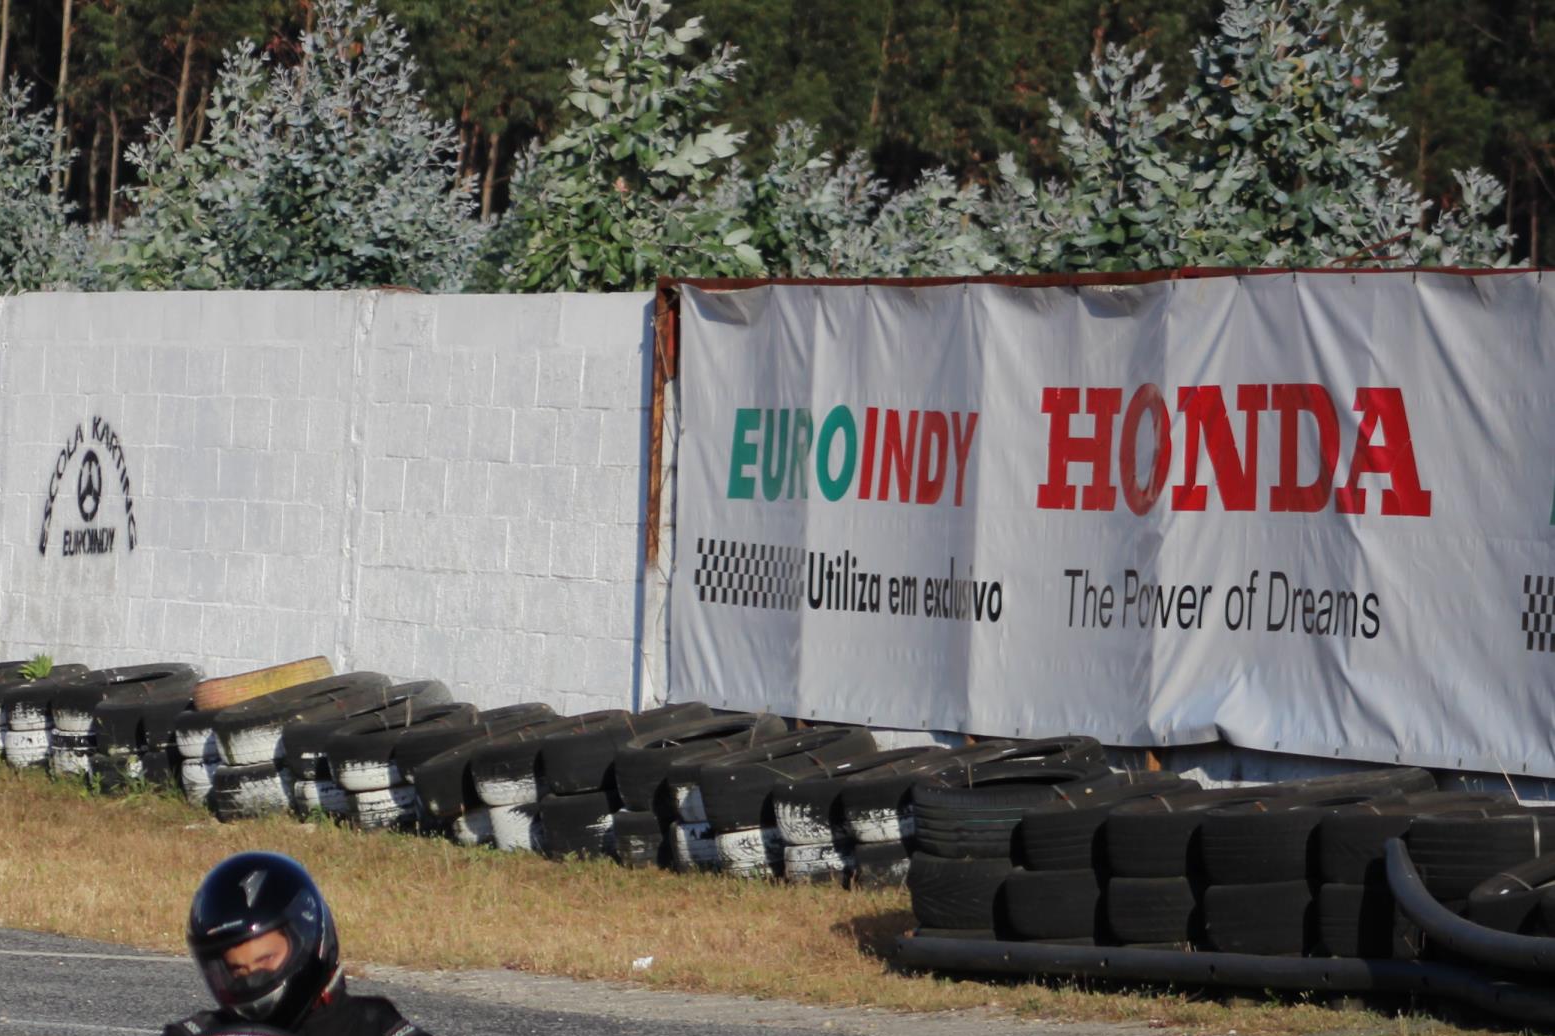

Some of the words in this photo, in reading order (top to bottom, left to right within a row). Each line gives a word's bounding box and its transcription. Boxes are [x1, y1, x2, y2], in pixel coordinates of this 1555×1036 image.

[726, 404, 979, 507] EUROINDY
[1037, 382, 1432, 517] HONDA
[62, 527, 116, 557] EUROINDY
[807, 550, 881, 613] Utiliza
[888, 575, 918, 616] em
[924, 556, 1004, 623] exclusivo
[1064, 568, 1115, 629] The
[1121, 568, 1213, 630] Power
[1224, 570, 1259, 632] of
[1266, 570, 1381, 640] Dreams
